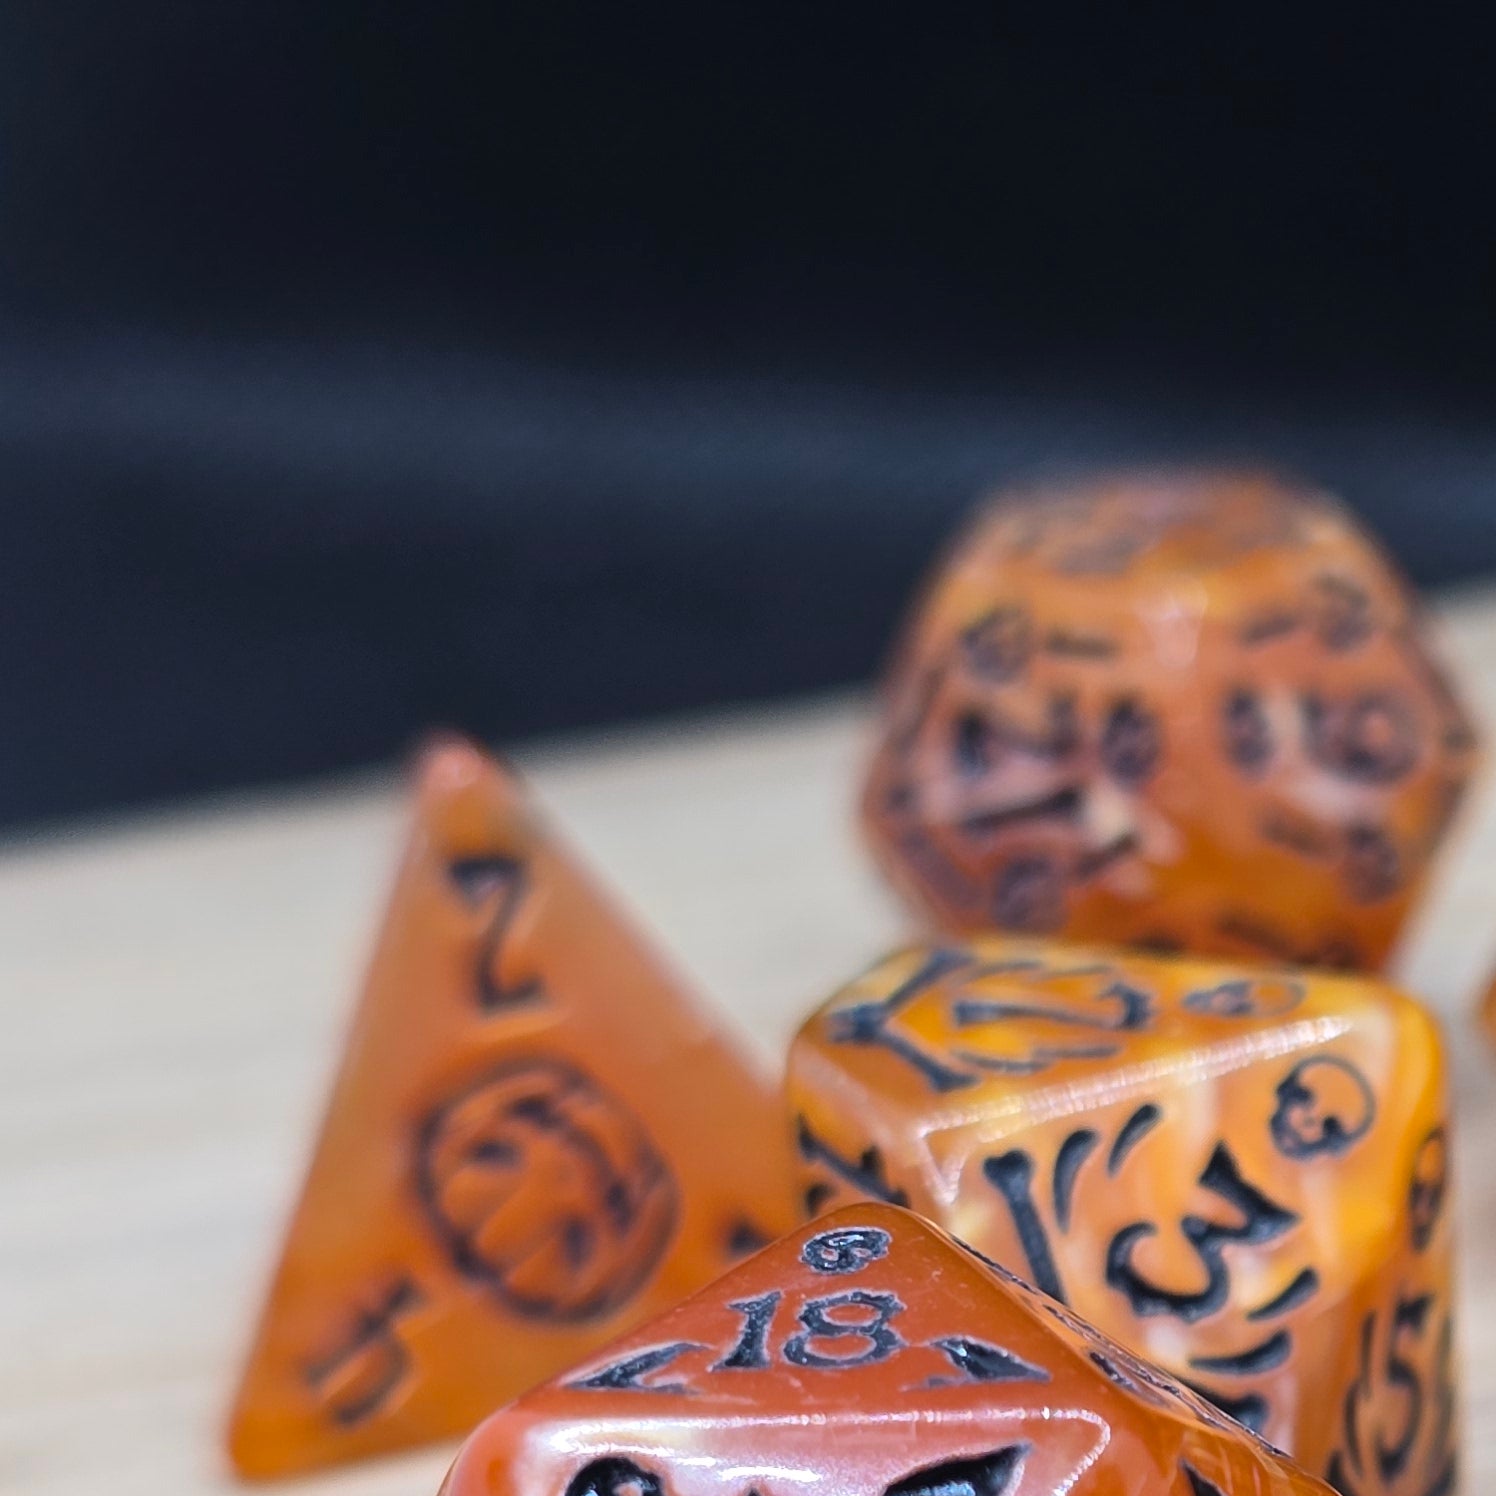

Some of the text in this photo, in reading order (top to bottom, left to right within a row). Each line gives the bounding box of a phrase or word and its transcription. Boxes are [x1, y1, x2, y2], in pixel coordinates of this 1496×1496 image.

[444, 852, 546, 1012] 2
[1105, 1138, 1302, 1324] 3
[706, 1288, 906, 1370] 18
